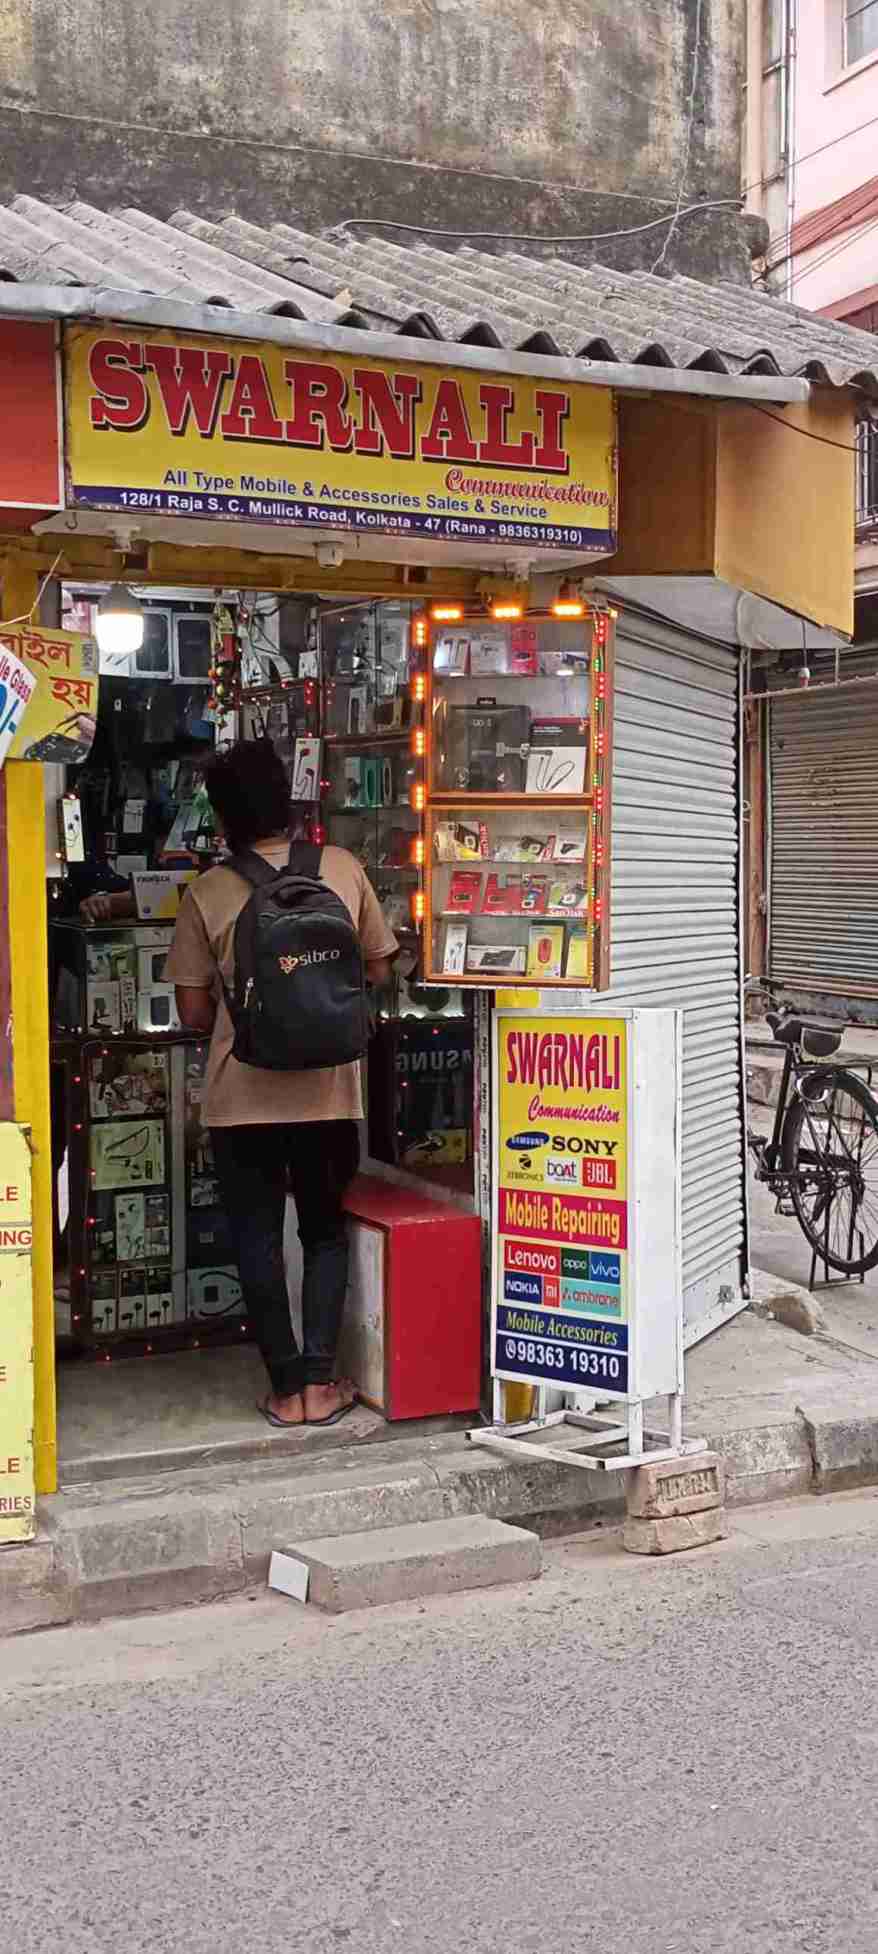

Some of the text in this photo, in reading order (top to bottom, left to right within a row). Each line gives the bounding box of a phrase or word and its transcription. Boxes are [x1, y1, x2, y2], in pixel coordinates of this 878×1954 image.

[88, 339, 571, 475] SWARNALI
[163, 469, 548, 519] All Type Mobile & Accessories Sales & Service
[444, 467, 609, 506] Communication
[120, 491, 162, 507] 128/1
[168, 495, 203, 512] Raja
[207, 497, 223, 512] S.
[228, 500, 244, 514] C.
[249, 500, 303, 518] Mullick
[308, 506, 351, 525] Road,
[356, 511, 411, 530] Kolkata
[424, 518, 441, 531] 47
[445, 519, 486, 535] (Rana
[499, 524, 583, 545] 9836319310)
[298, 948, 341, 967] sibco
[506, 1031, 621, 1094] SWARNALI
[527, 1094, 620, 1123] Communication
[551, 1135, 619, 1156] SONY
[586, 1161, 614, 1185] JBL
[505, 1191, 620, 1245] Mobile Repairing
[507, 1245, 557, 1271] Lenovo
[590, 1260, 620, 1279] vivo
[505, 1280, 540, 1296] NOKIA
[506, 1311, 618, 1346] Mobile Accessories
[517, 1341, 620, 1378] 98363 19310
